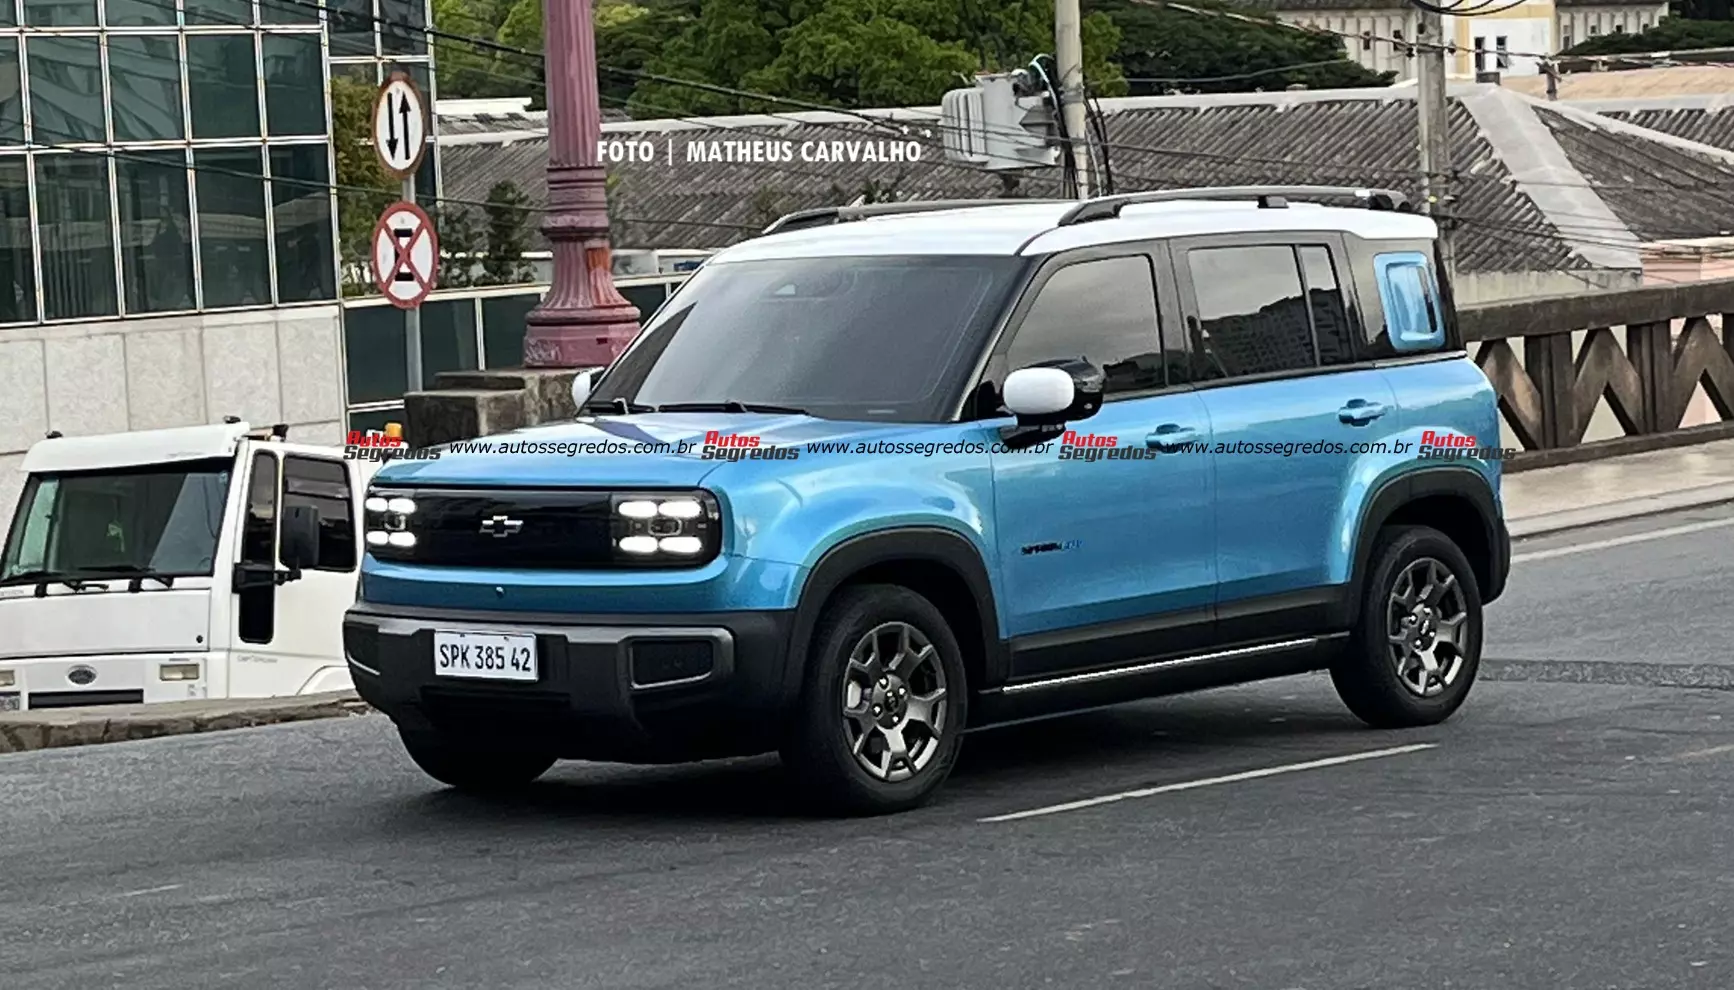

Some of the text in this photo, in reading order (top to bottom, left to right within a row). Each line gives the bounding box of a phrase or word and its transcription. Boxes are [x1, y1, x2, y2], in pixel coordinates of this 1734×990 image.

[440, 644, 532, 672] SPK 385 42
